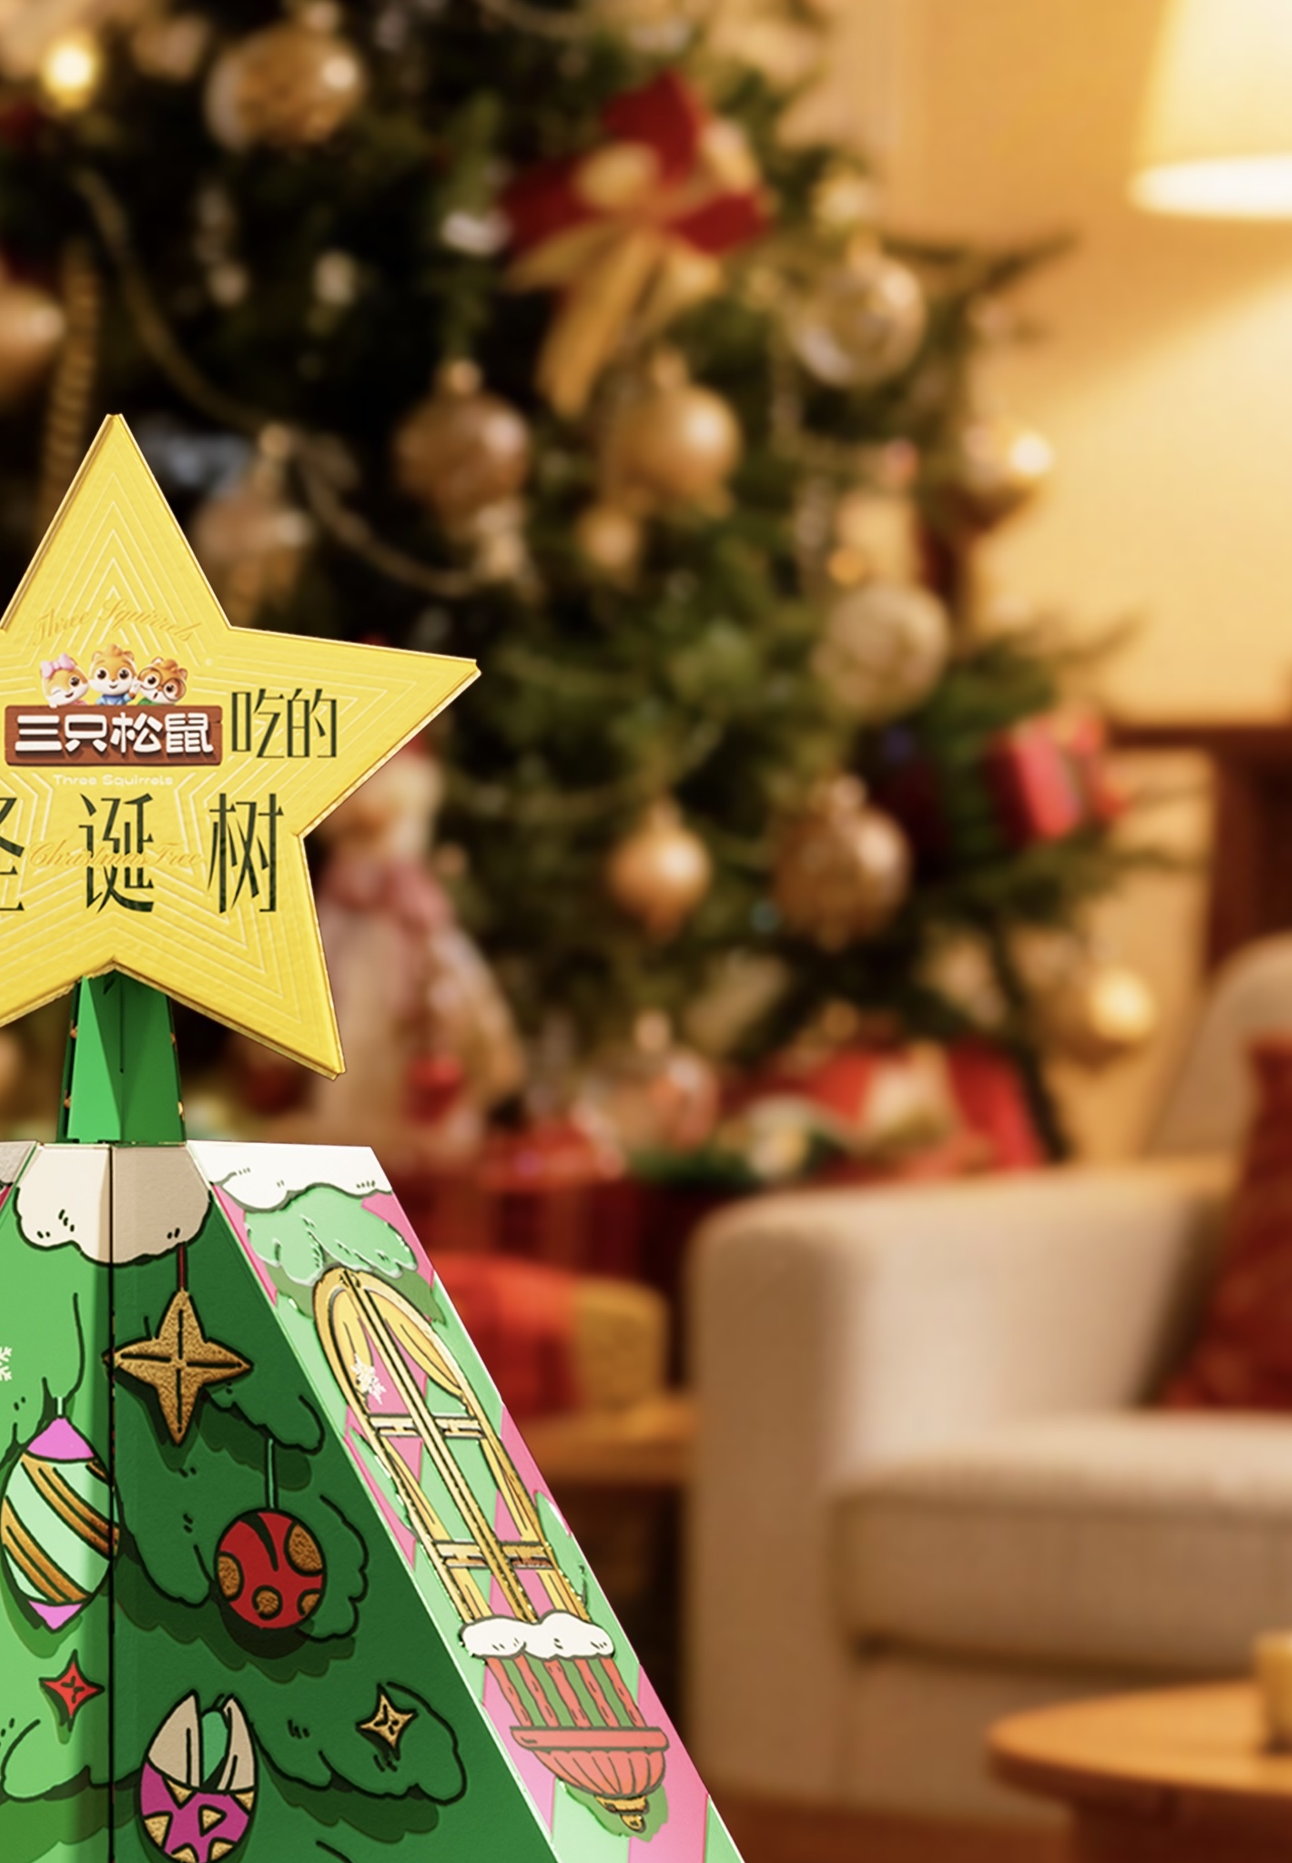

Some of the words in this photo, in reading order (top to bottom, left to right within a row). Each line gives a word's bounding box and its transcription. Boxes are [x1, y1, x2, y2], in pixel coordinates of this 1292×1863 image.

[15, 712, 214, 753] 三只松鼠
[231, 688, 337, 759] 吃的
[53, 774, 97, 786] Three
[102, 774, 174, 787] Squirrels
